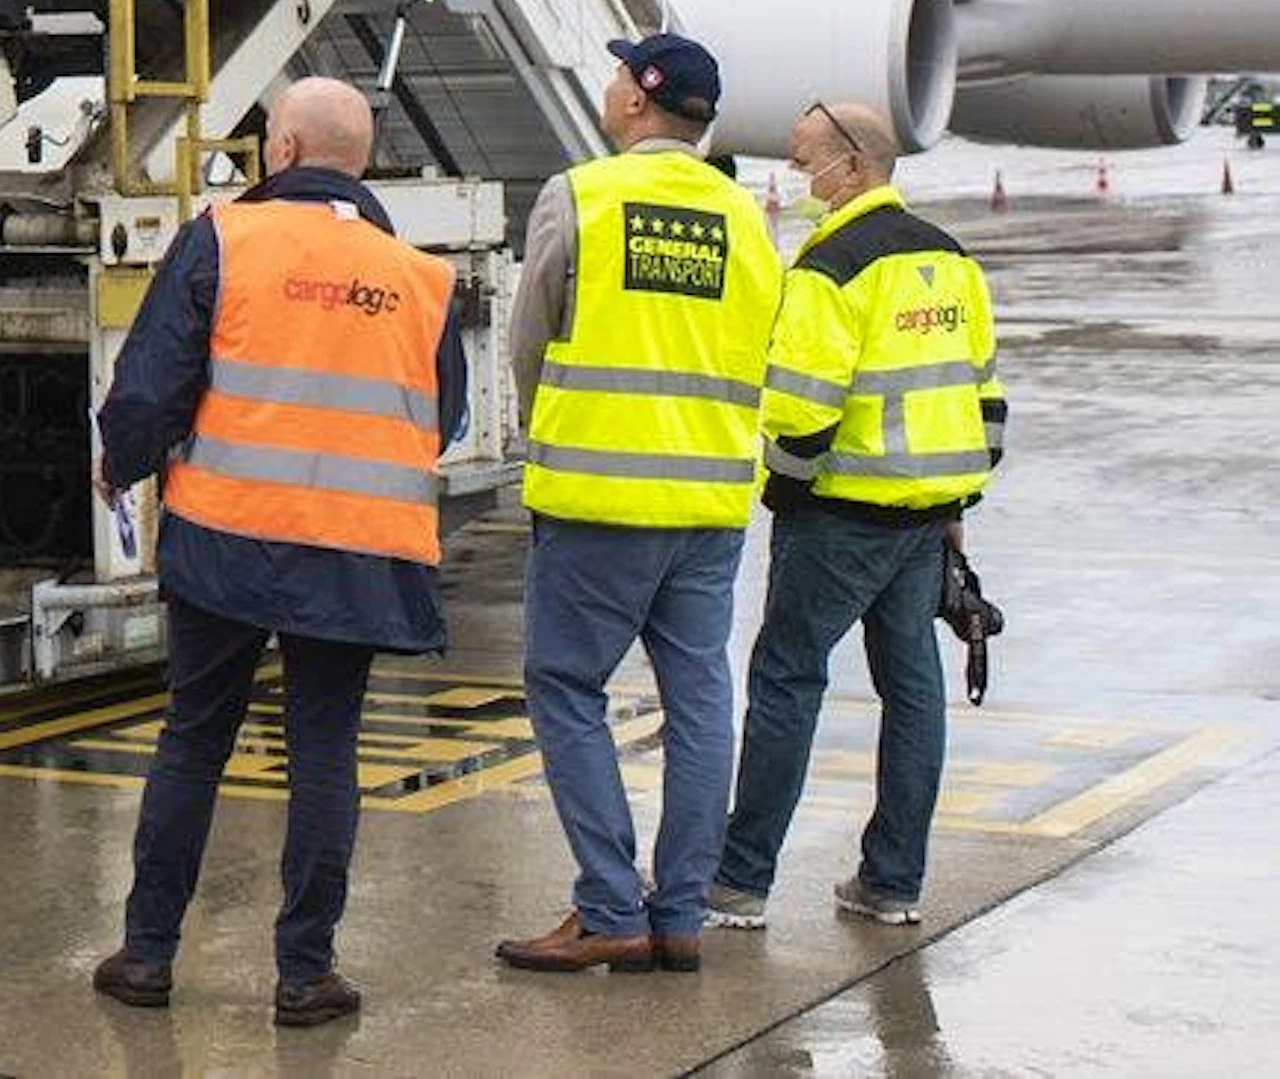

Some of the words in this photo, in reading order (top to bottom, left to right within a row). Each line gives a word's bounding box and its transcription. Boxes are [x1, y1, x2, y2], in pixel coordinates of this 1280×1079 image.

[629, 236, 723, 263] GENERAL
[630, 254, 723, 289] TRANSPORT
[284, 278, 400, 317] cargologc
